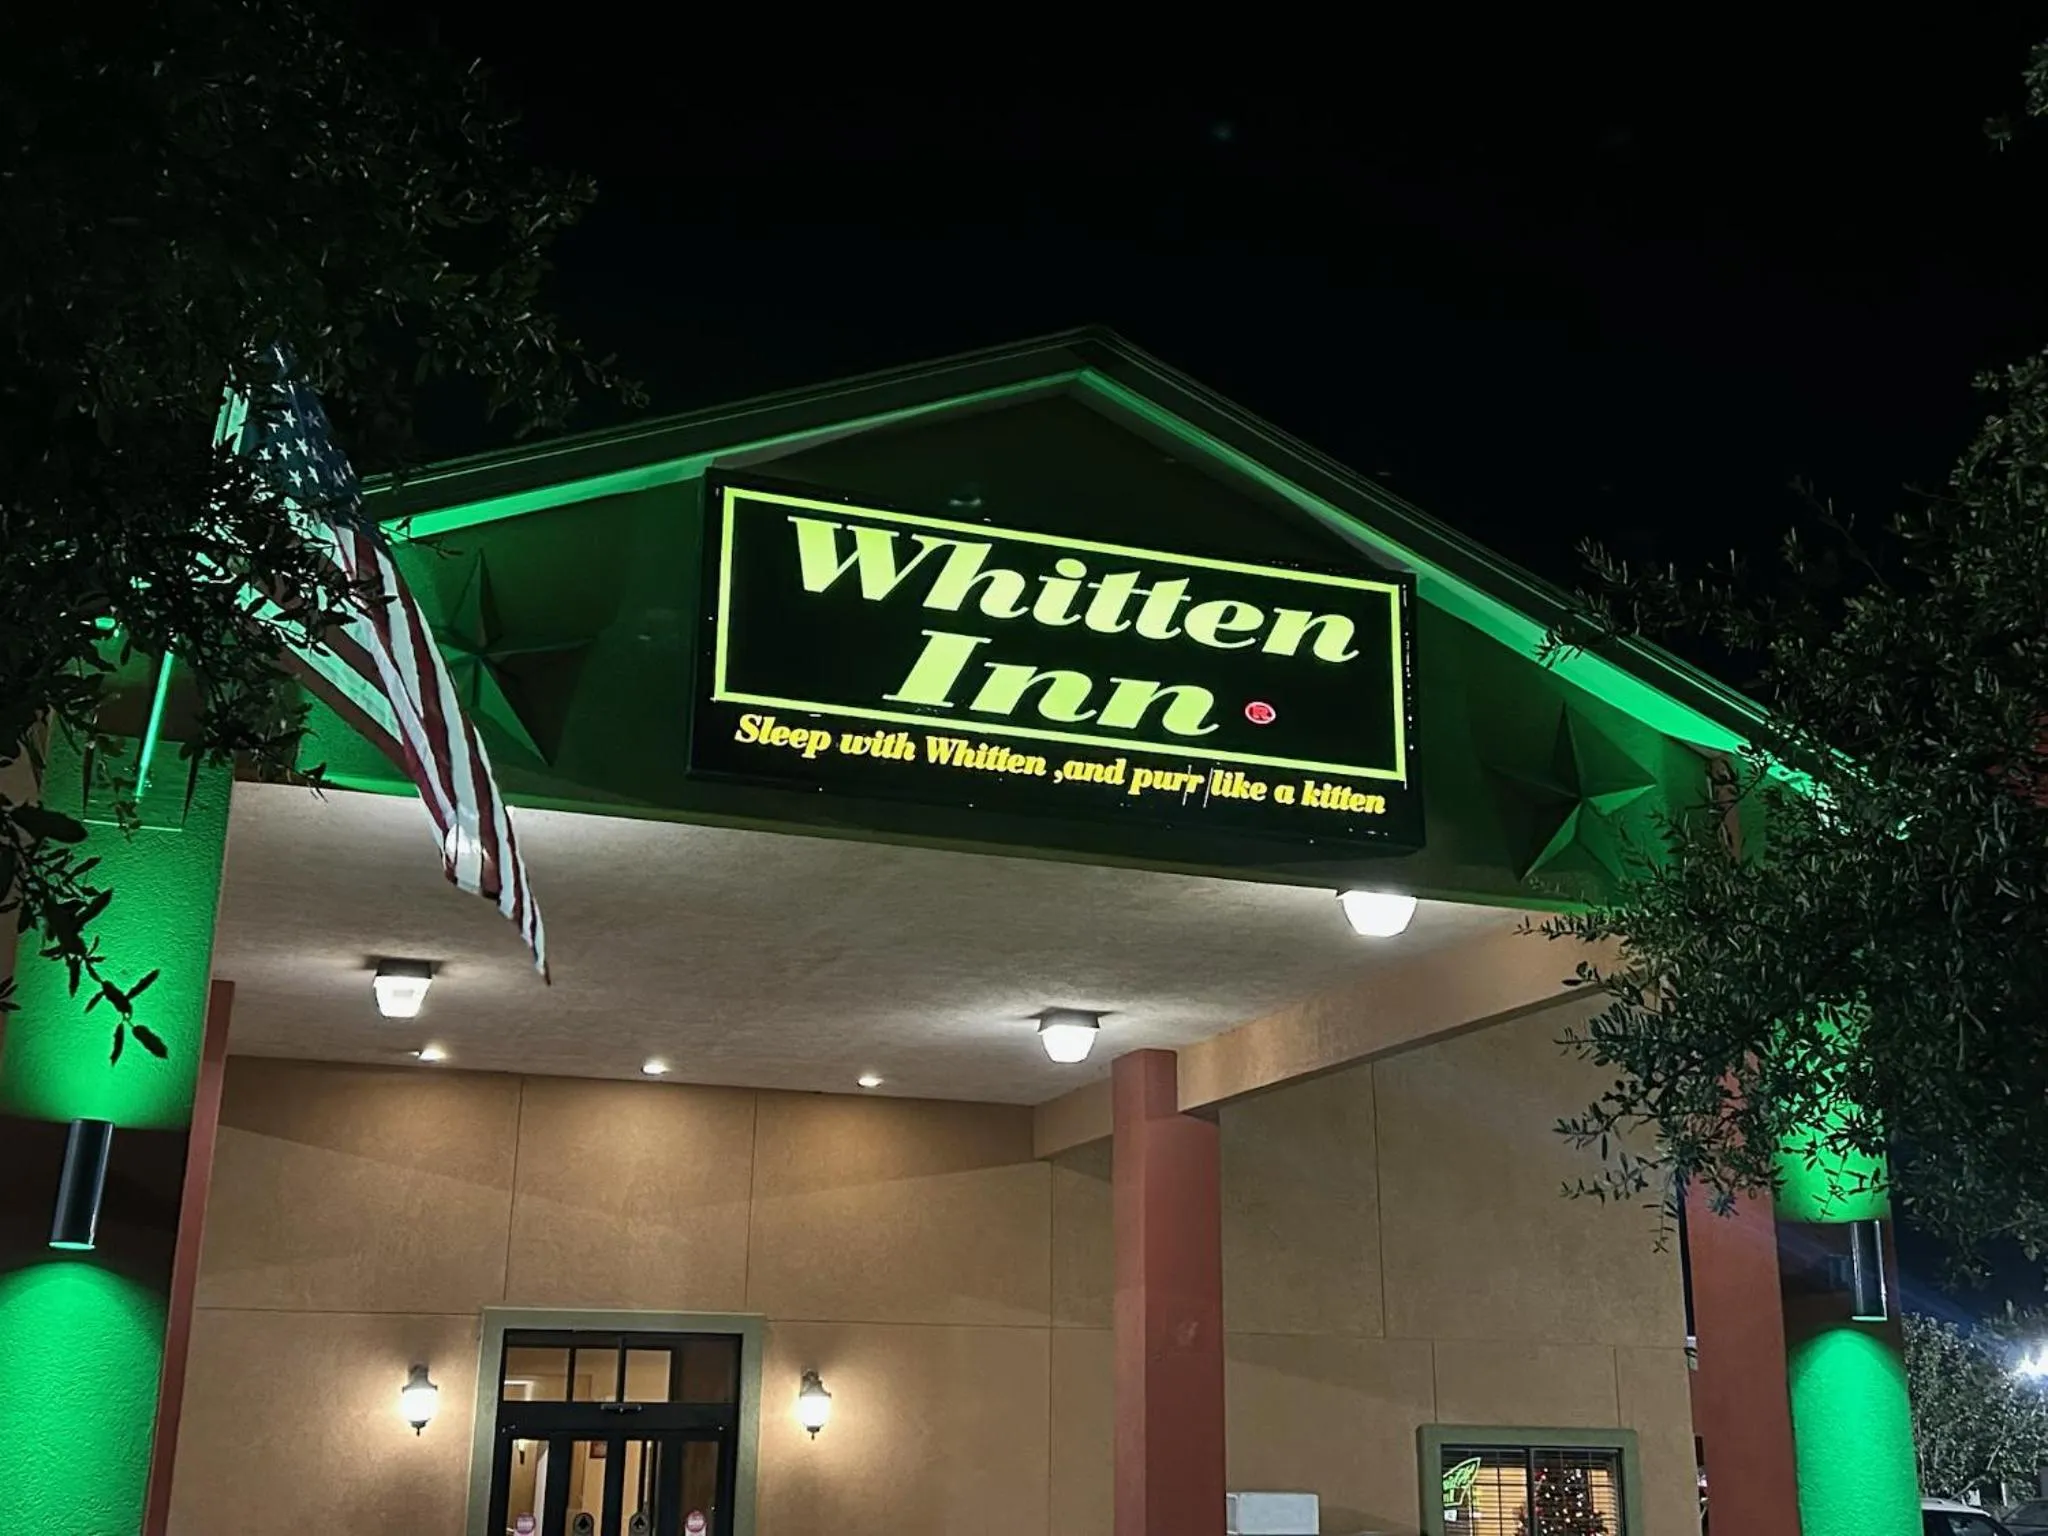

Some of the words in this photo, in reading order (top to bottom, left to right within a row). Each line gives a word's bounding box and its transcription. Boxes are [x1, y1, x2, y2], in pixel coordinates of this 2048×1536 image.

[787, 515, 1360, 663] Whitten
[882, 629, 1220, 737] Inn
[734, 713, 832, 759] Sleep
[839, 730, 917, 762] with
[925, 735, 1047, 777] Whitten
[1129, 767, 1206, 796] purr
[1210, 768, 1268, 801] like
[1273, 785, 1295, 805] a
[1300, 780, 1387, 814] kitten
